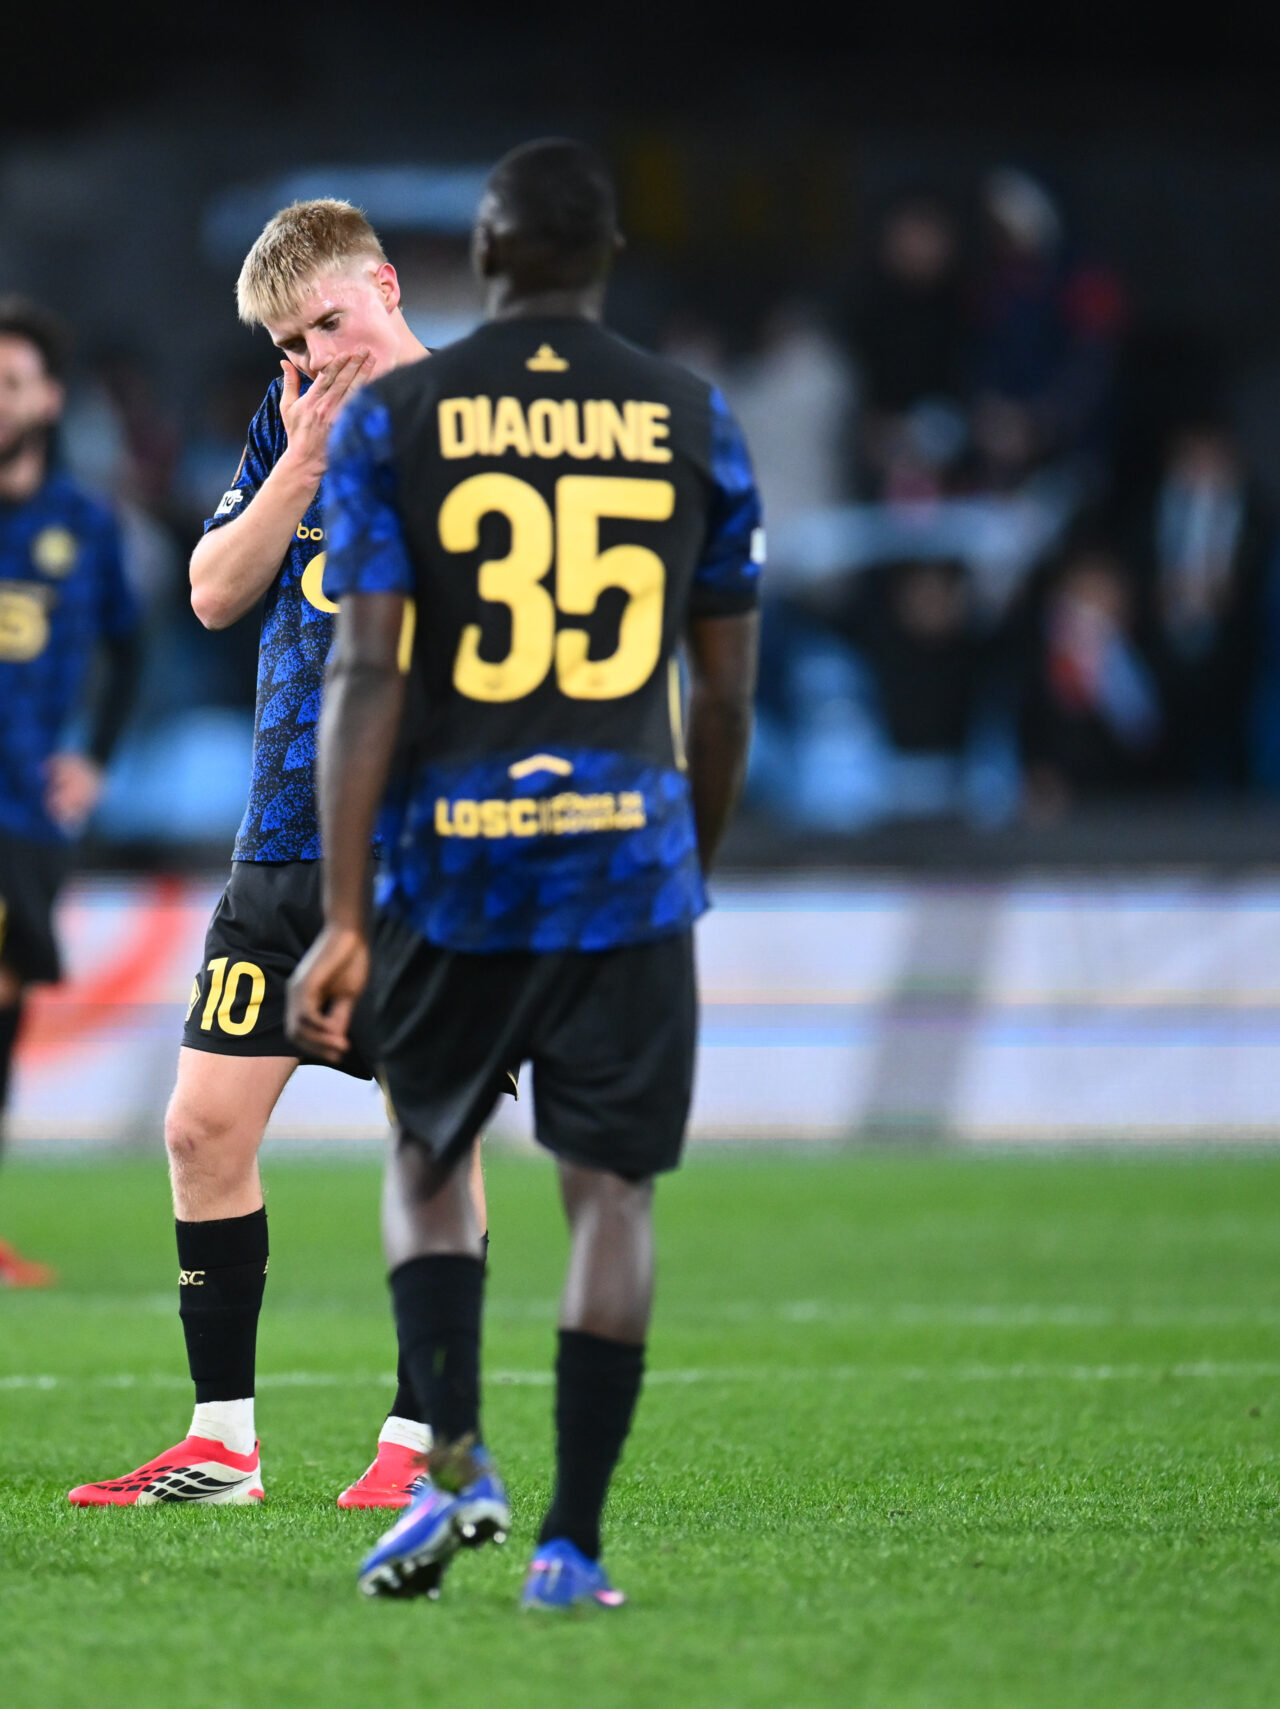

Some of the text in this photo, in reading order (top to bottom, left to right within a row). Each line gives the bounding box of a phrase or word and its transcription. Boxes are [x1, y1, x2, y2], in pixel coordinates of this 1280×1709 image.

[438, 396, 672, 464] DIAOUNE
[296, 522, 328, 541] bo
[438, 473, 677, 702] 35
[435, 797, 539, 838] LOSC
[200, 957, 265, 1036] 10
[178, 1269, 205, 1286] SC
